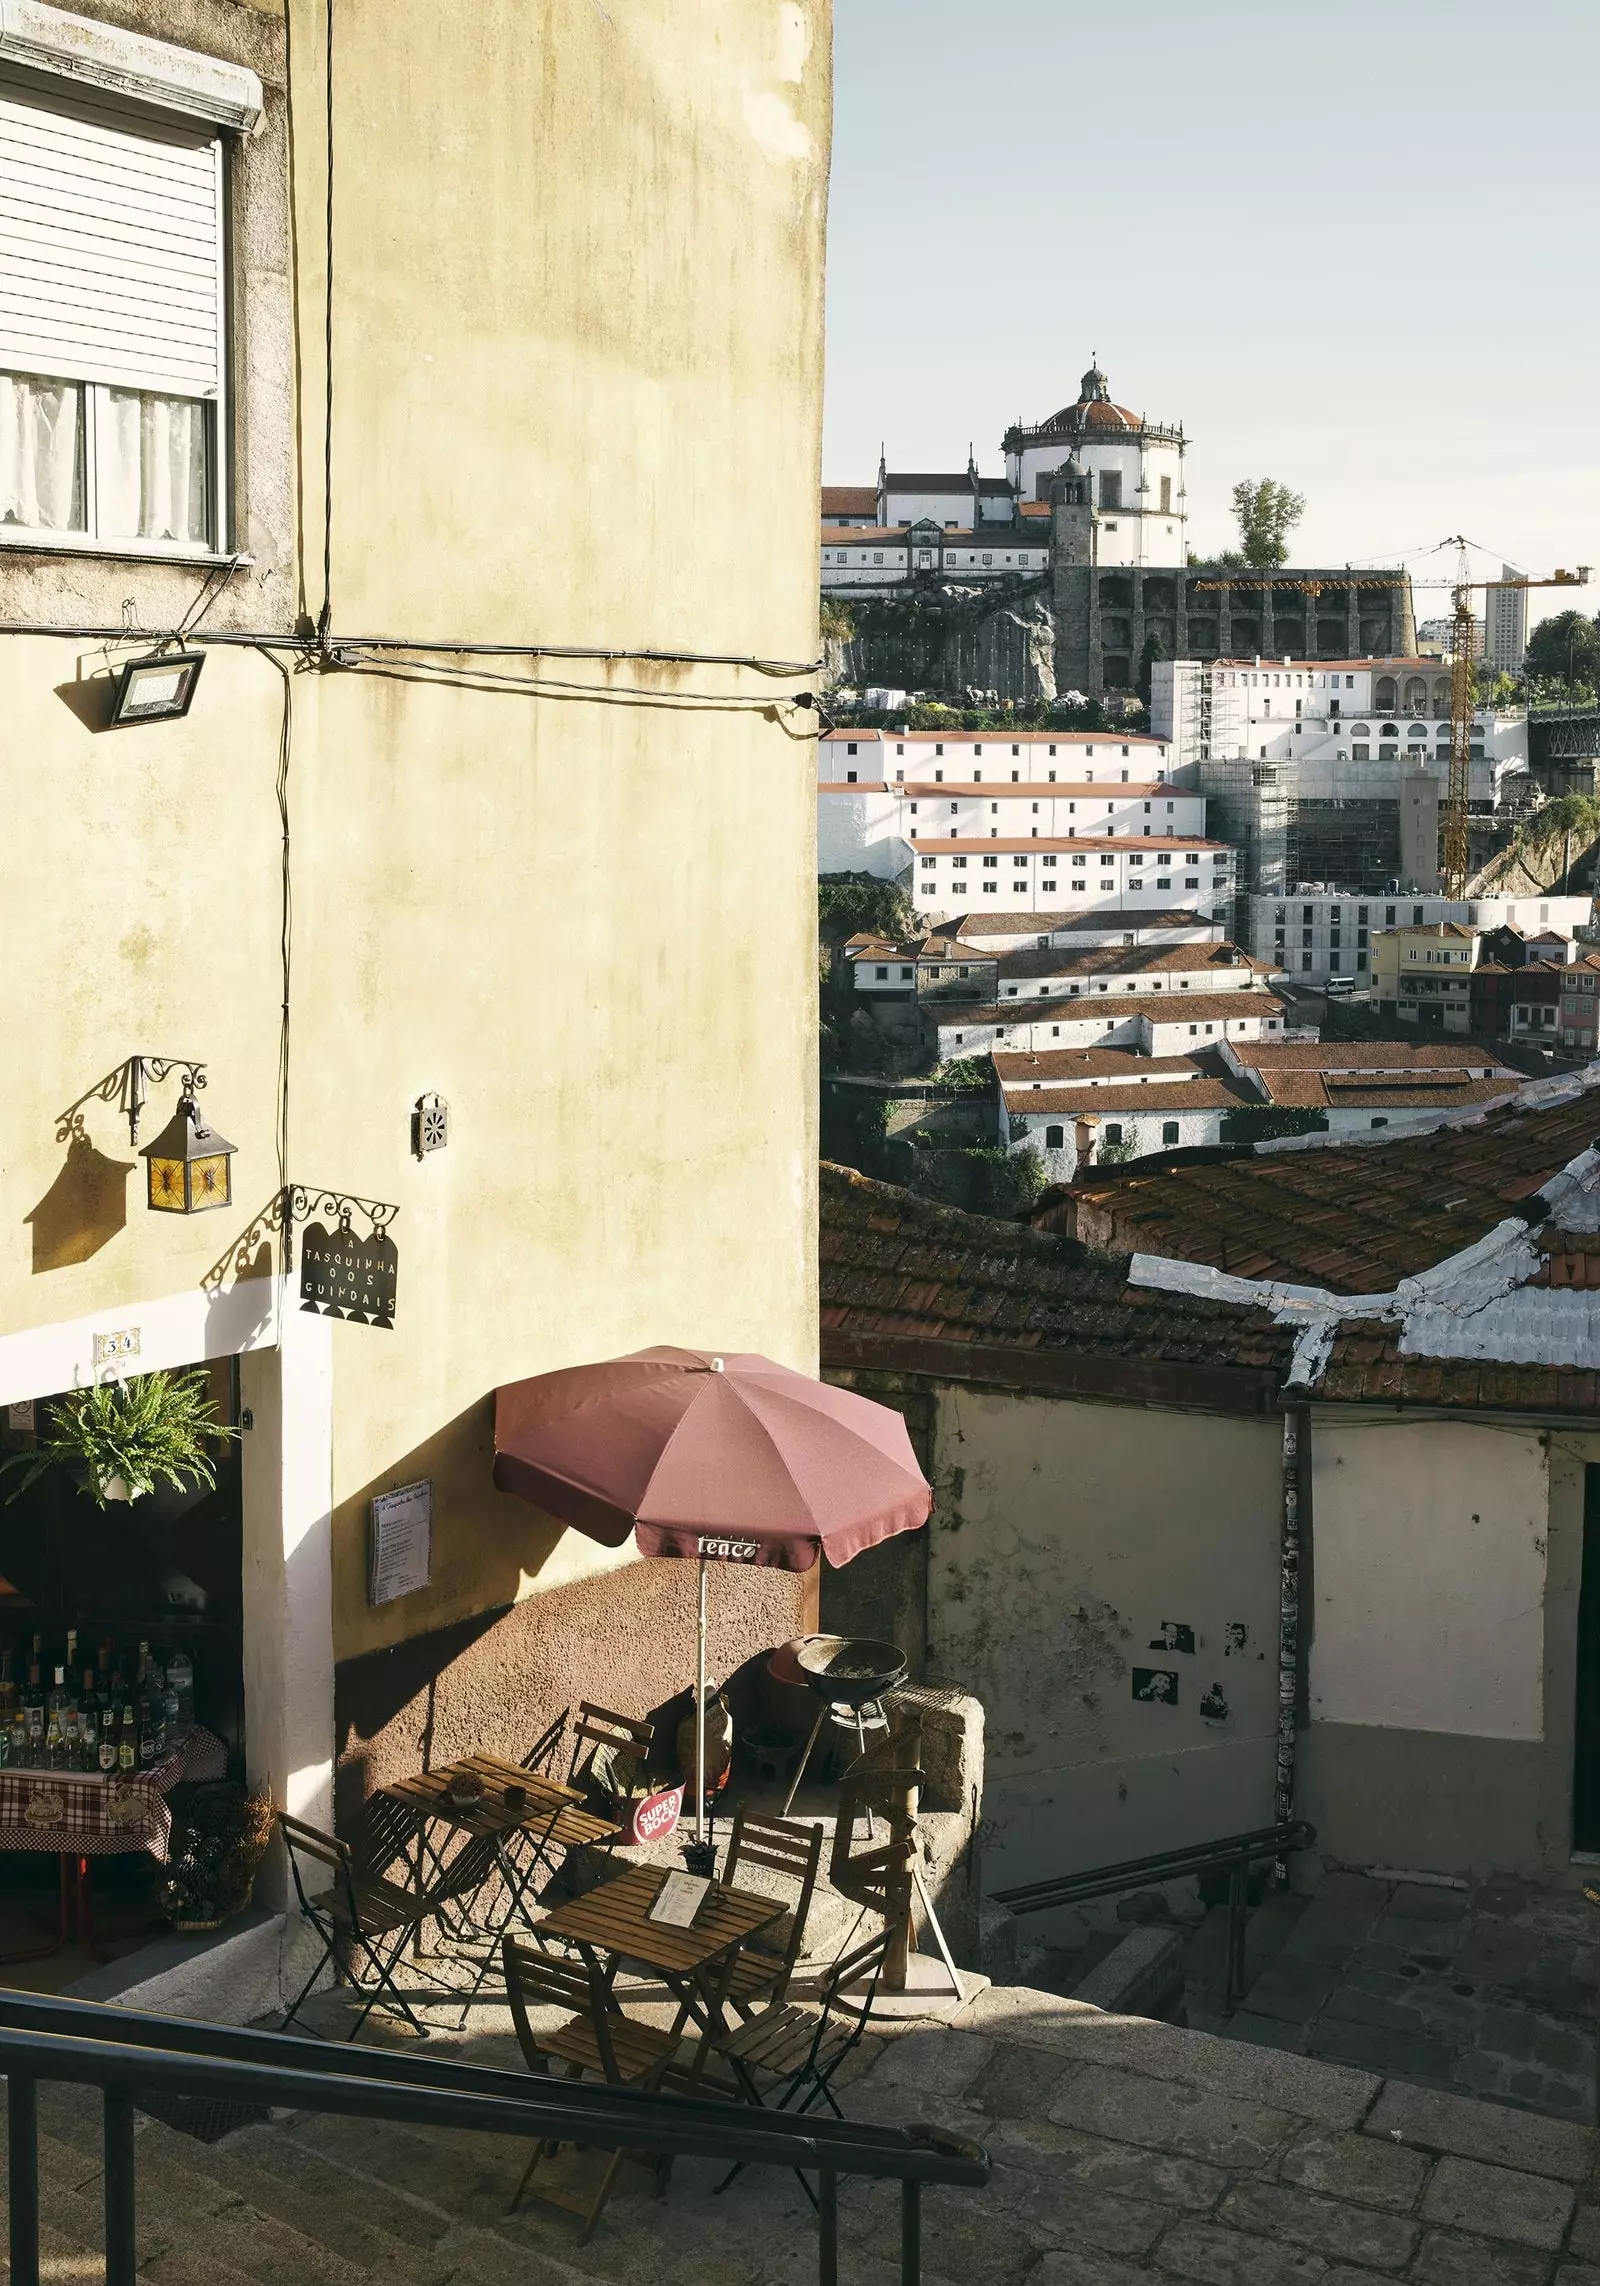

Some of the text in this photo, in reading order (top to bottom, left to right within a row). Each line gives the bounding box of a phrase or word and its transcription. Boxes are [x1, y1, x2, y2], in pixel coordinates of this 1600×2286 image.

[348, 1240, 354, 1248] A
[305, 1249, 395, 1275] TASQUINHA
[330, 1267, 374, 1286] DOS
[305, 1282, 396, 1311] GUINDAIS
[107, 1336, 132, 1353] 34
[639, 1794, 676, 1826] SUPER
[643, 1808, 677, 1836] BOCK
